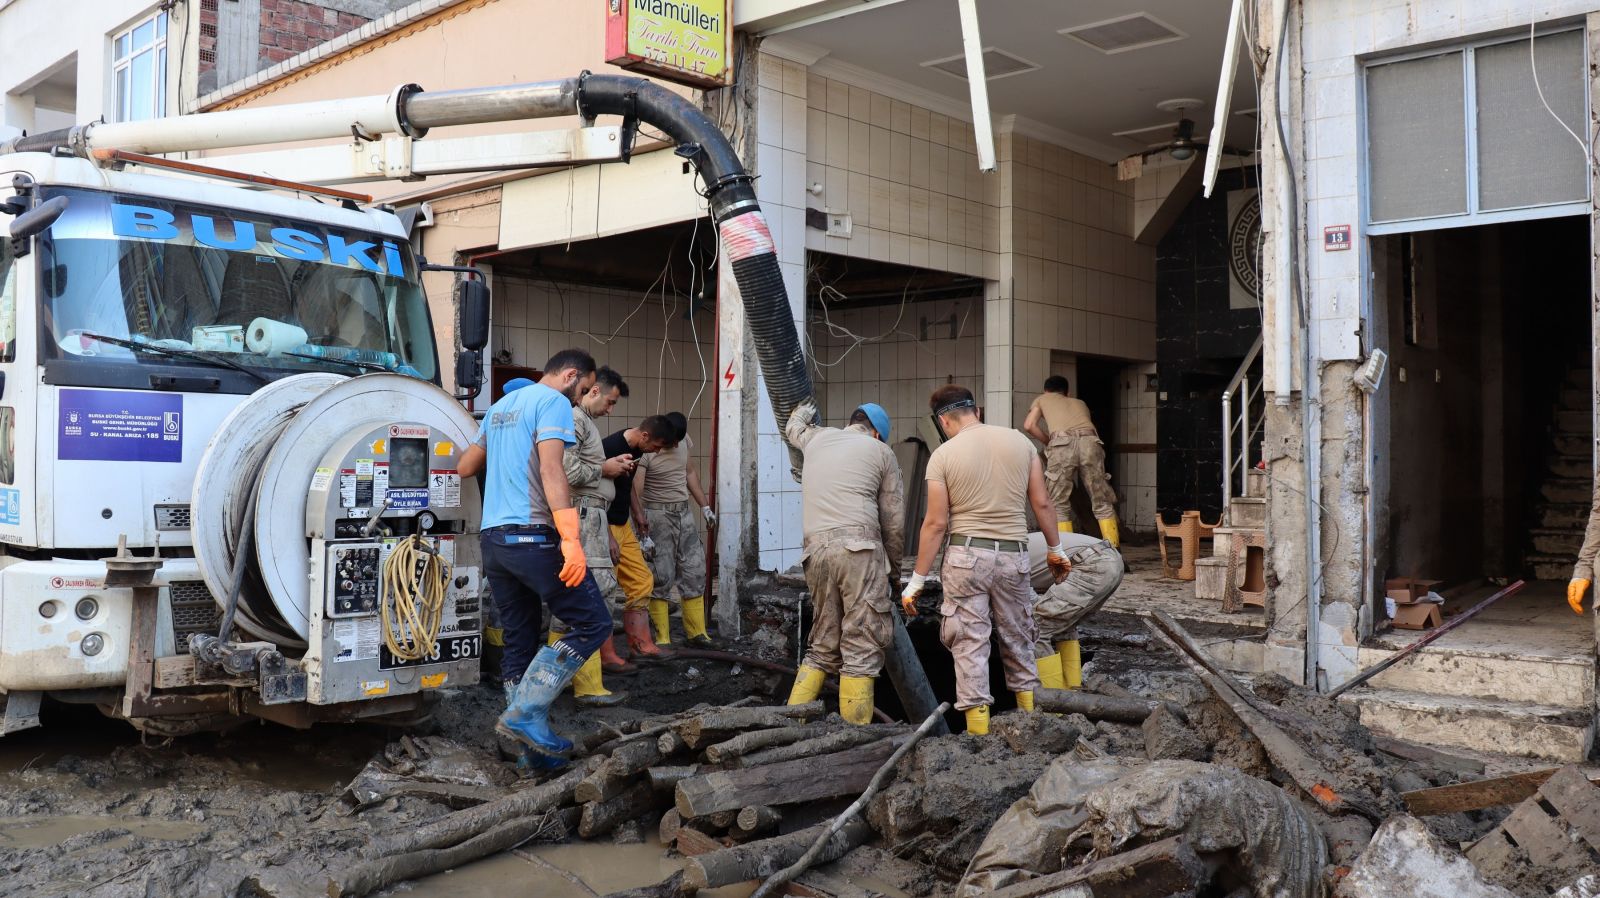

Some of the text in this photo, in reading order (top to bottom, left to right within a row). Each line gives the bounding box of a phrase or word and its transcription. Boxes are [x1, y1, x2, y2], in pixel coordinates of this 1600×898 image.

[634, 0, 719, 34] Mamülleri
[635, 16, 679, 47] Tarihi
[1332, 232, 1344, 242] 13
[451, 638, 478, 658] 561
